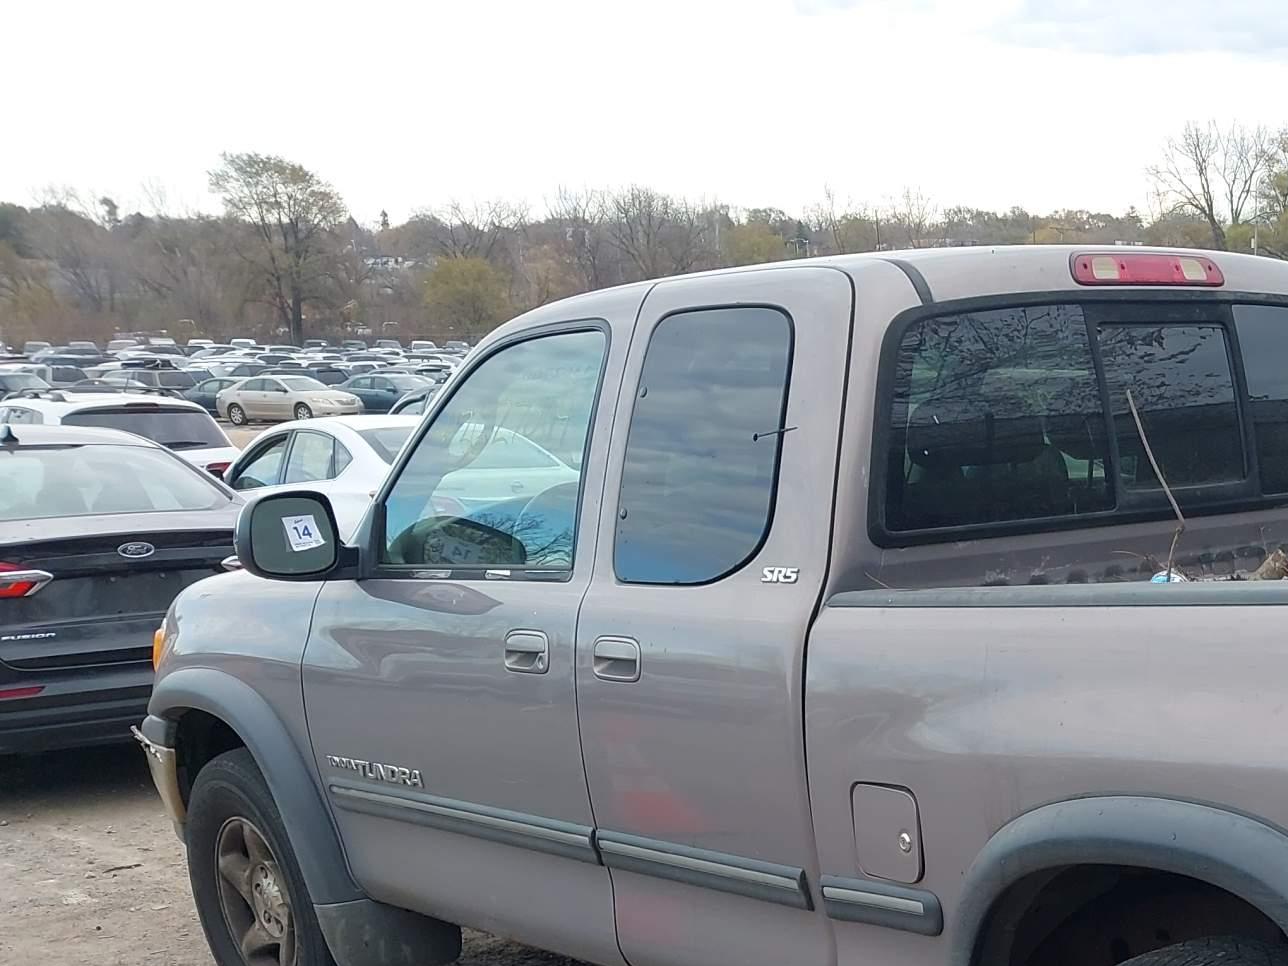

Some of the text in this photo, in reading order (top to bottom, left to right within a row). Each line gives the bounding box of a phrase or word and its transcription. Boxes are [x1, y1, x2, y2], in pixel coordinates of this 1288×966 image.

[293, 525, 312, 540] 14
[760, 566, 800, 584] SR5
[1, 632, 56, 641] FUSION
[354, 759, 424, 788] TUNDRA
